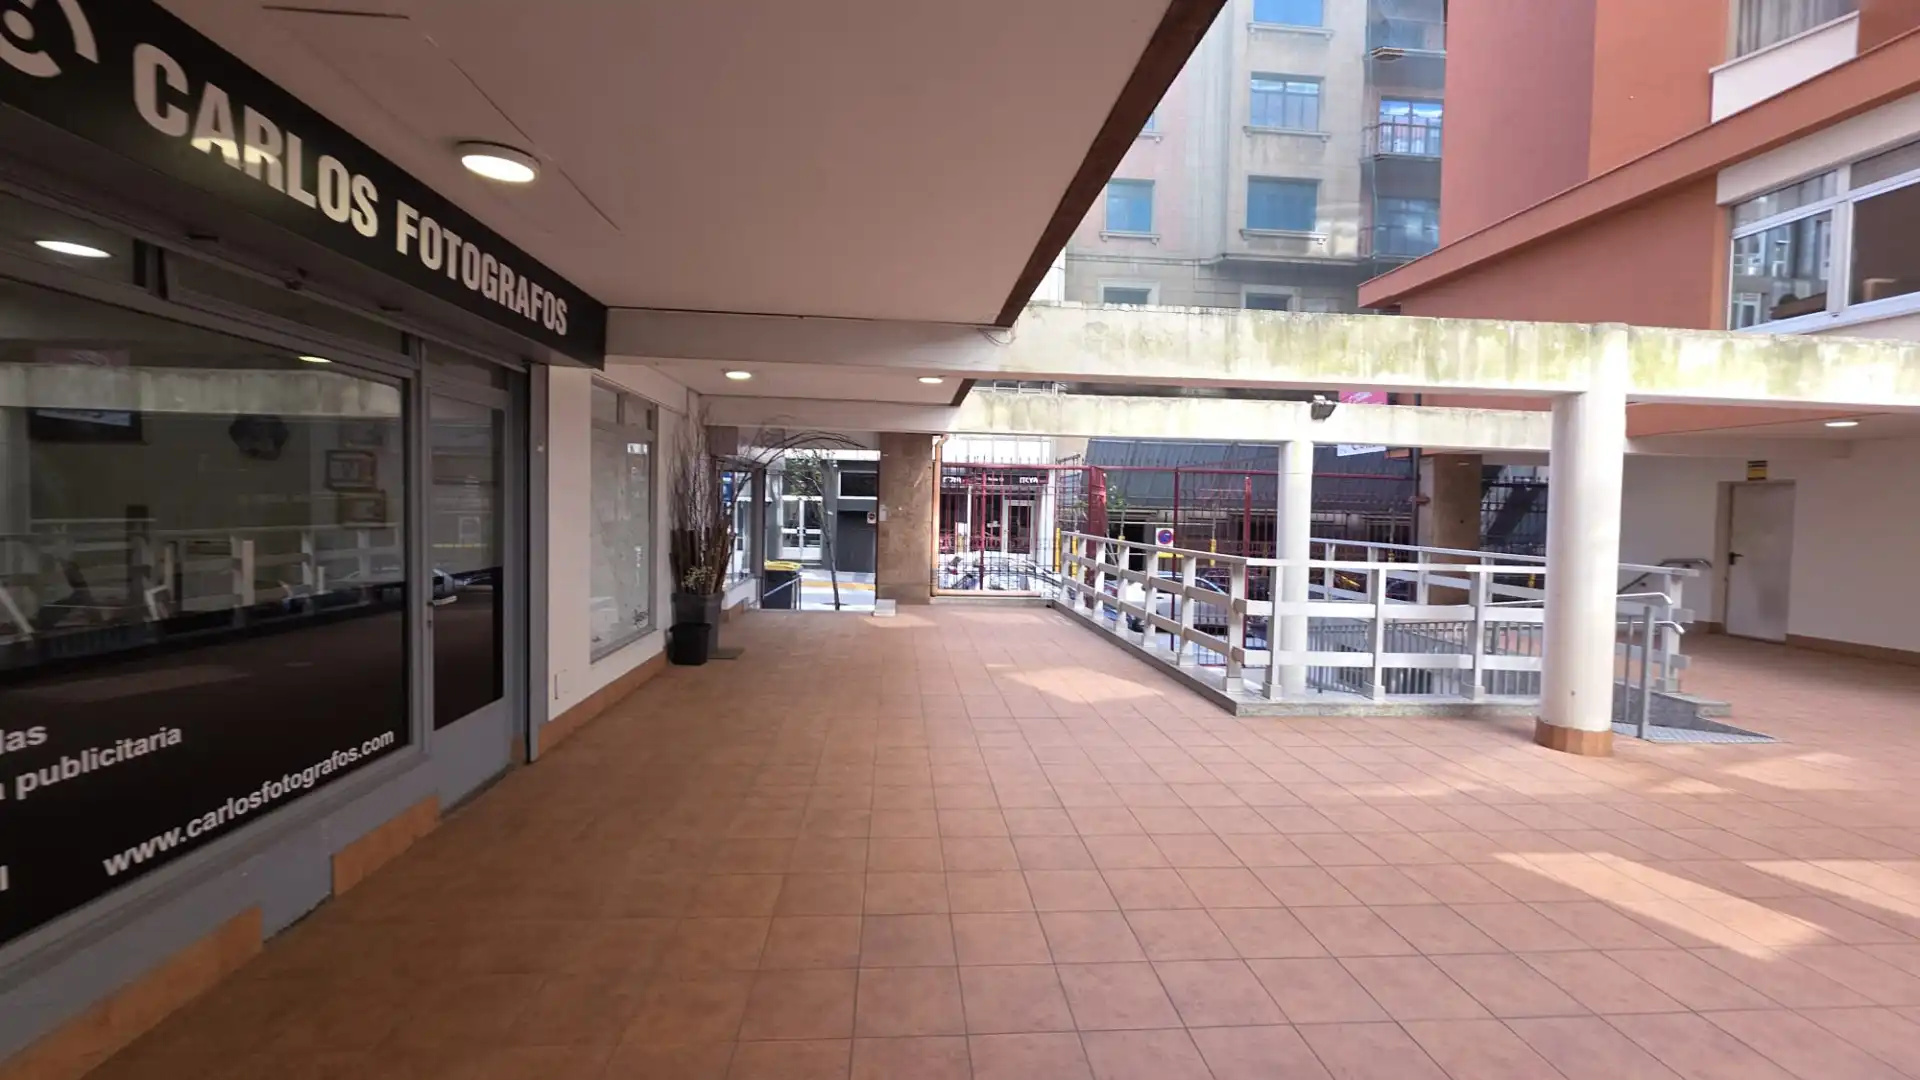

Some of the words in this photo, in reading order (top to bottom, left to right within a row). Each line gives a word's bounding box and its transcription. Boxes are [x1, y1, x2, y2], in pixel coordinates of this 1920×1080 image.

[133, 43, 379, 238] CARLOS
[396, 199, 569, 336] FOTOGRAFOS
[15, 727, 182, 800] publicitaria
[102, 730, 394, 876] www.carlosfotografos.com
